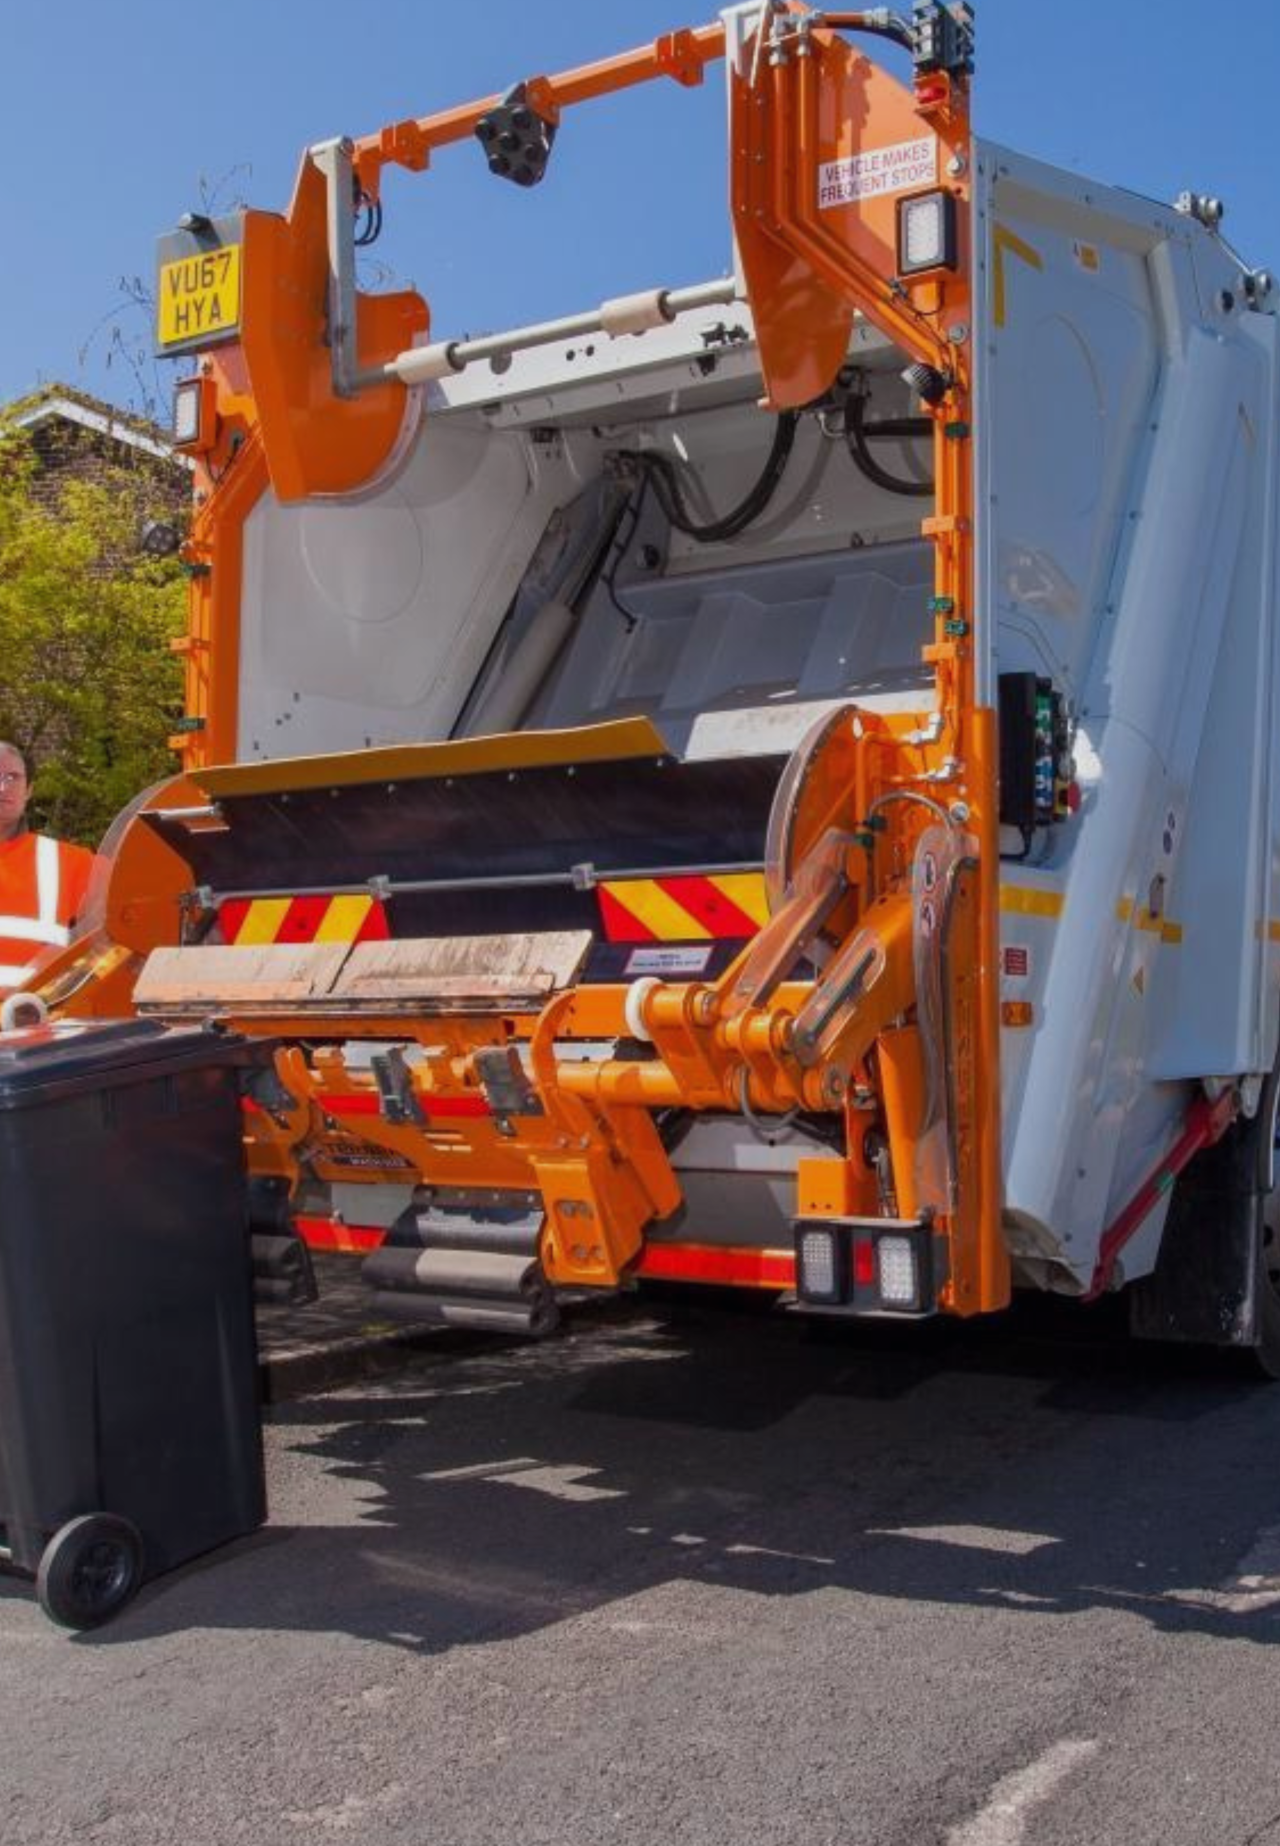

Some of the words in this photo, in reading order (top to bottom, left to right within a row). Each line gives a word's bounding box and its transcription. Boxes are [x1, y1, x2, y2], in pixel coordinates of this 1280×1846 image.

[821, 171, 889, 202] FREQUENT
[892, 162, 935, 185] STOPS
[826, 155, 879, 182] VEHICLE
[883, 142, 930, 168] MAKES
[170, 251, 232, 298] VU67
[174, 292, 222, 335] HYA
